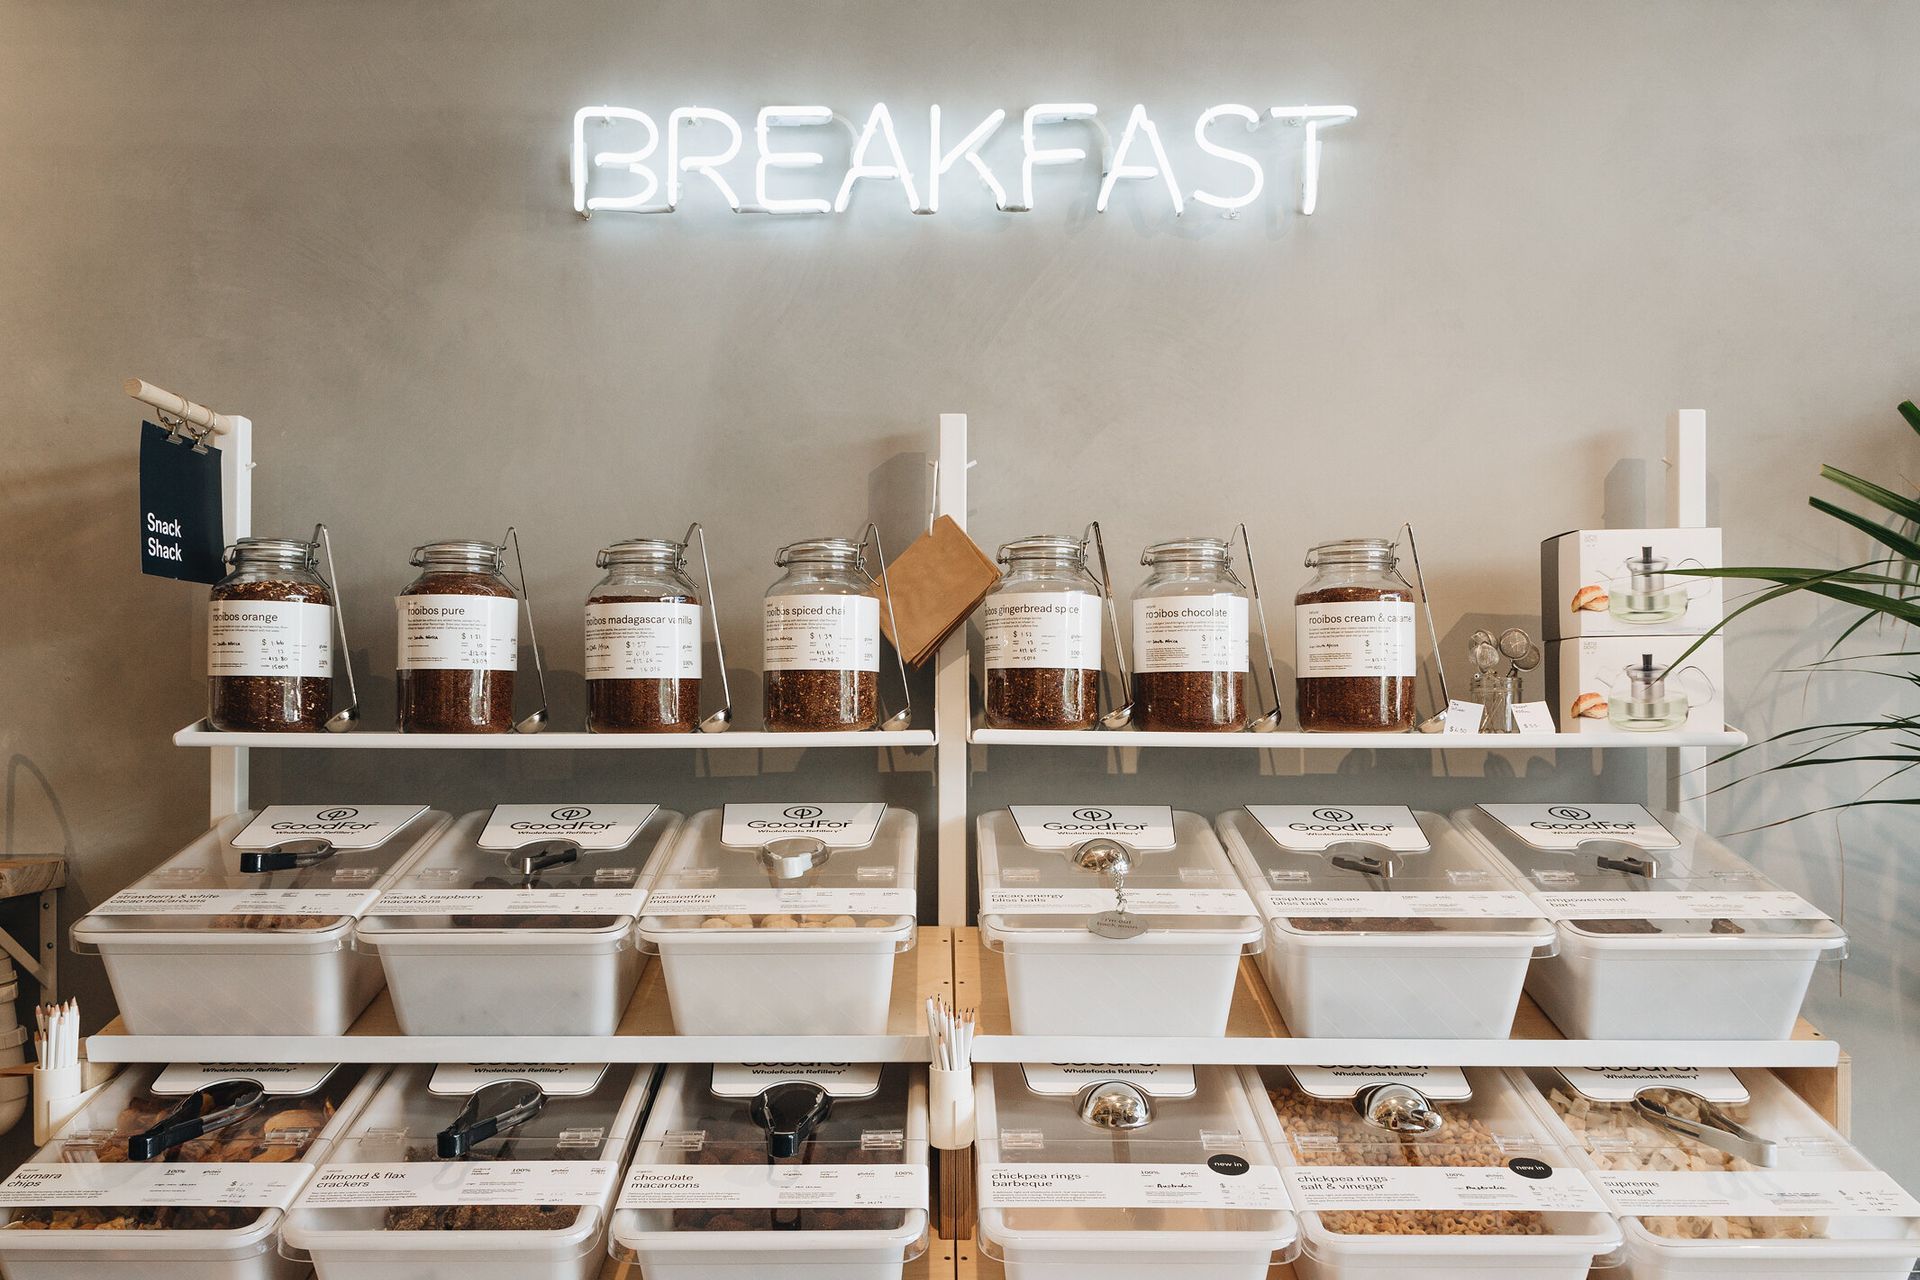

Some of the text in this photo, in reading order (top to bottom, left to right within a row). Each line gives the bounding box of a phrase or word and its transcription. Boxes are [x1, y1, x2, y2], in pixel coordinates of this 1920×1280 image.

[572, 102, 1359, 217] BREAKFAST
[147, 512, 182, 538] Snack
[147, 537, 183, 562] Shack
[407, 605, 465, 617] rooibos pure
[791, 605, 823, 617] spiced
[998, 603, 1052, 617] gingerbread
[1054, 605, 1080, 616] spce
[1145, 607, 1228, 618] rooibos chocolate
[241, 613, 278, 624] orange
[608, 614, 665, 627] madagascar
[1309, 613, 1342, 625] rooibos
[1344, 614, 1376, 625] cream
[15, 1172, 63, 1180] kumara
[321, 1171, 407, 1181] almond & flax
[633, 1174, 695, 1182] chocolate
[991, 1172, 1047, 1181] chickpea
[1050, 1172, 1083, 1182] rings
[1297, 1175, 1354, 1184] chickpea
[1356, 1175, 1388, 1184] rings
[7, 1179, 42, 1188] chips
[316, 1180, 370, 1189] crackers
[630, 1182, 701, 1190] macaroons
[991, 1180, 1053, 1189] barbeque
[1300, 1182, 1385, 1192] salt & vinegar
[1603, 1181, 1660, 1189] supreme
[1609, 1188, 1656, 1197] nougat
